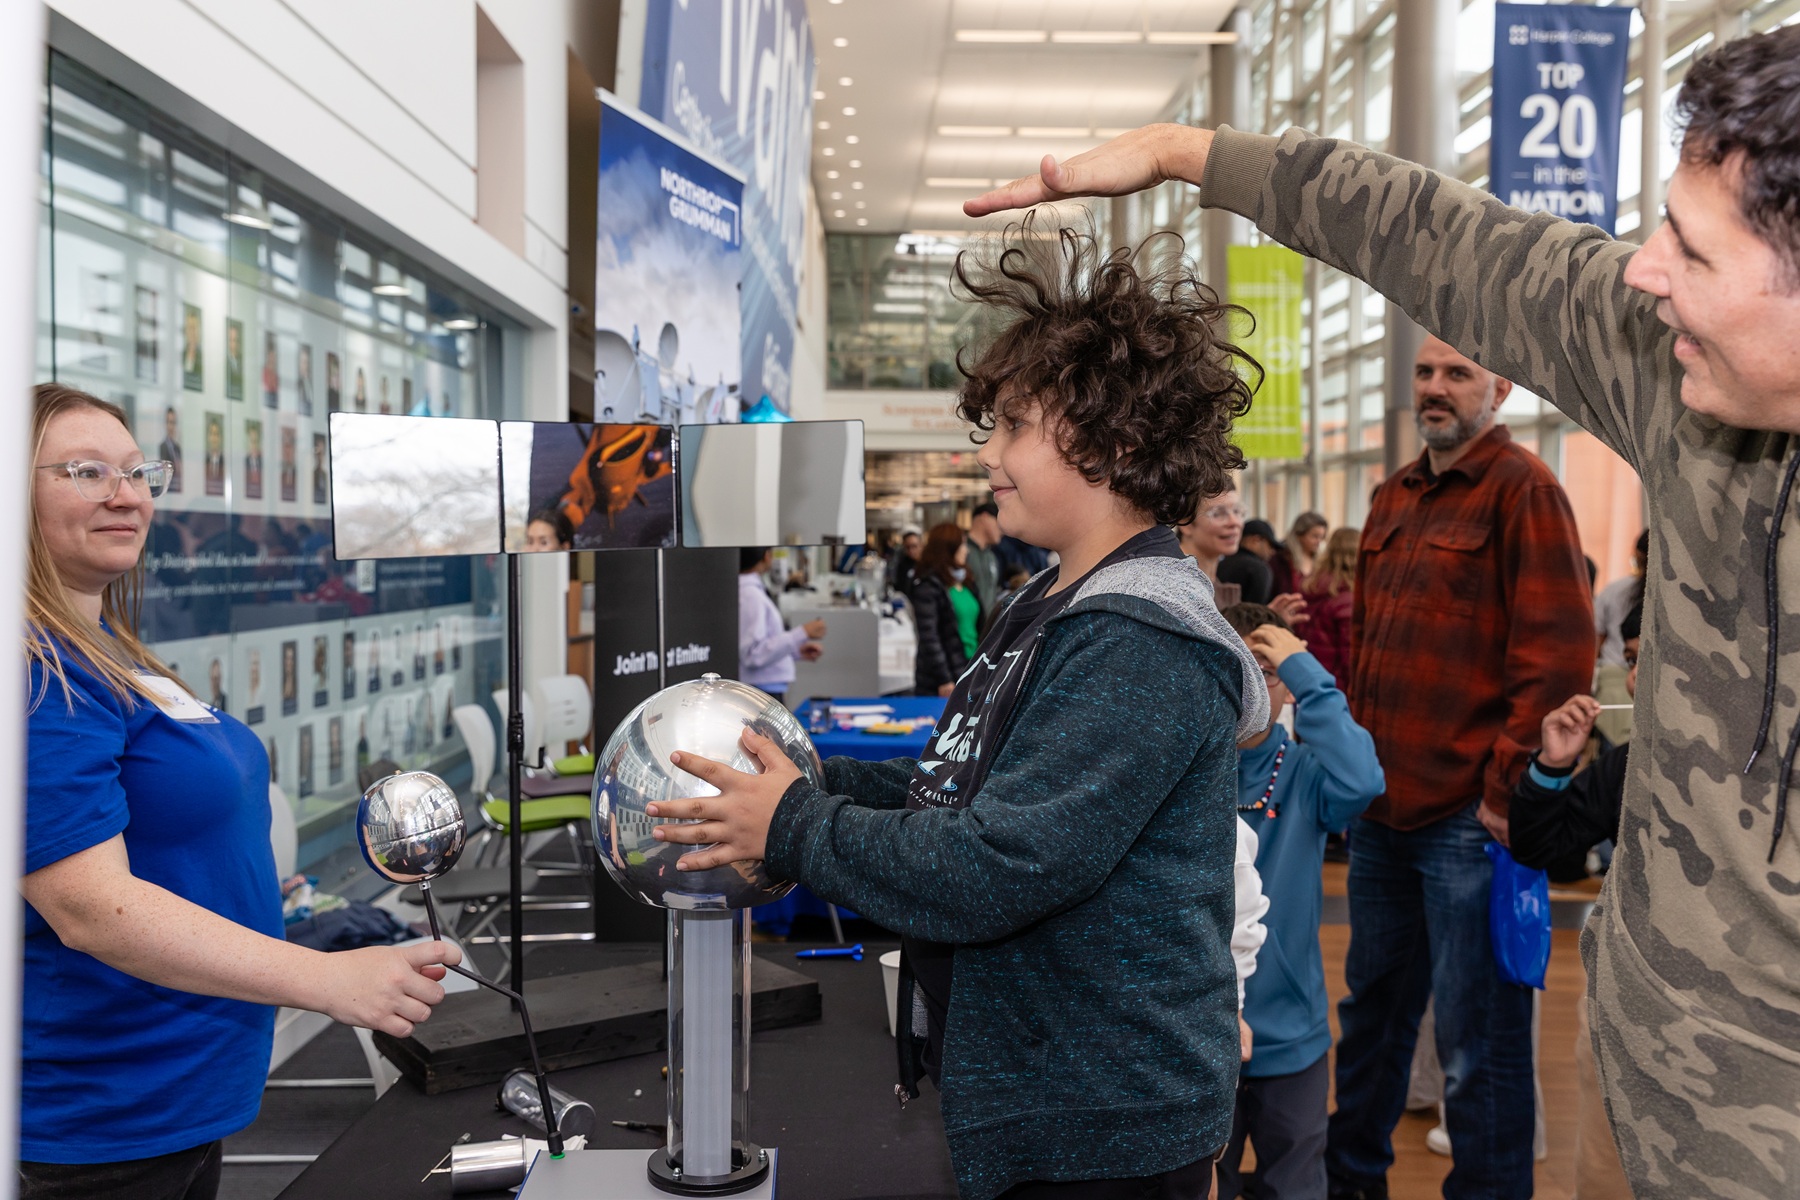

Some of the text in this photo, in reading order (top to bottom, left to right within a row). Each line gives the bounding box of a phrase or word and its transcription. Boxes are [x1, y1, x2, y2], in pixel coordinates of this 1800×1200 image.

[1537, 62, 1585, 89] TOP
[1519, 93, 1598, 159] 20
[1533, 163, 1588, 185] in the
[660, 166, 723, 216] NORTHROP
[1509, 189, 1605, 216] NATION
[669, 195, 731, 243] GRUMMAN
[613, 651, 646, 676] Joint
